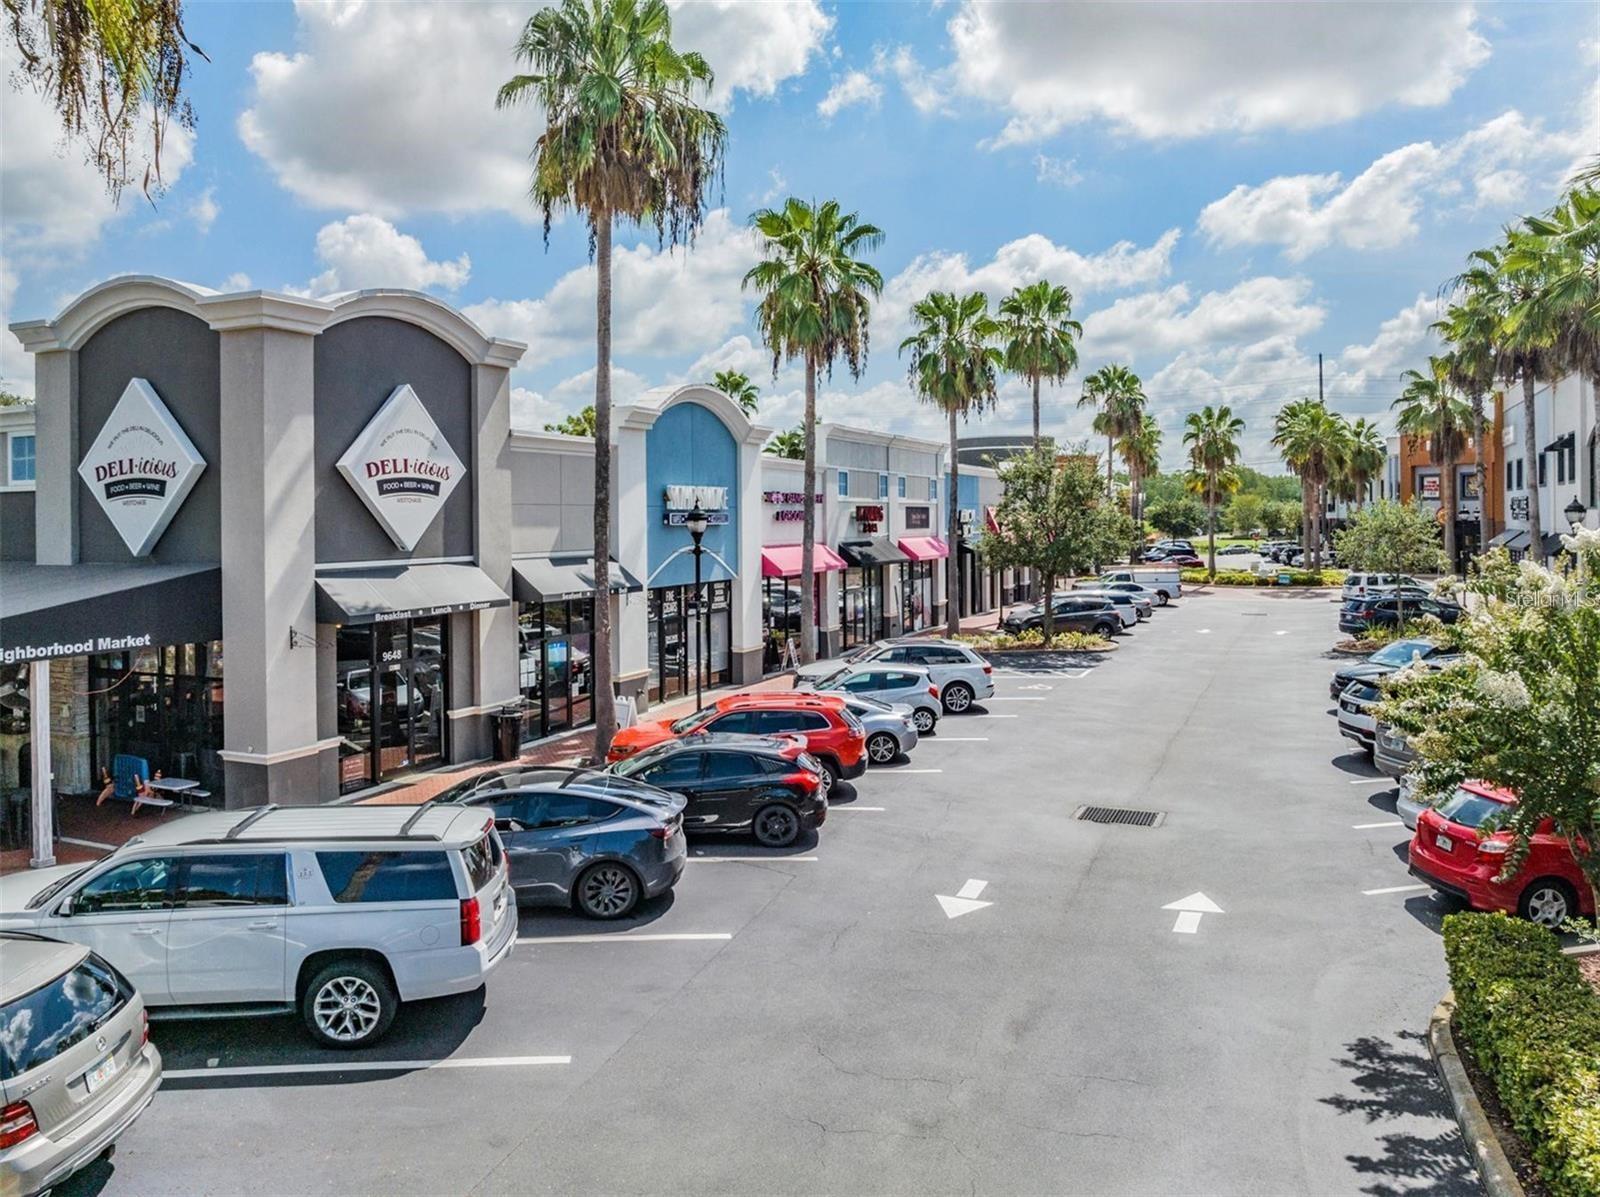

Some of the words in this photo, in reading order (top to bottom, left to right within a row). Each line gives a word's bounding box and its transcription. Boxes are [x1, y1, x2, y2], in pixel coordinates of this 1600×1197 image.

[109, 483, 126, 494] FOOD
[128, 482, 142, 490] BEER
[146, 482, 161, 492] WINE
[382, 482, 399, 491] FOOD
[403, 480, 418, 489] BEER
[421, 481, 435, 491] WINE
[375, 610, 412, 622] Breakfast
[431, 605, 453, 615] Lunch
[469, 601, 491, 611] Dinner
[98, 633, 151, 651] Market
[382, 649, 402, 663] 9648
